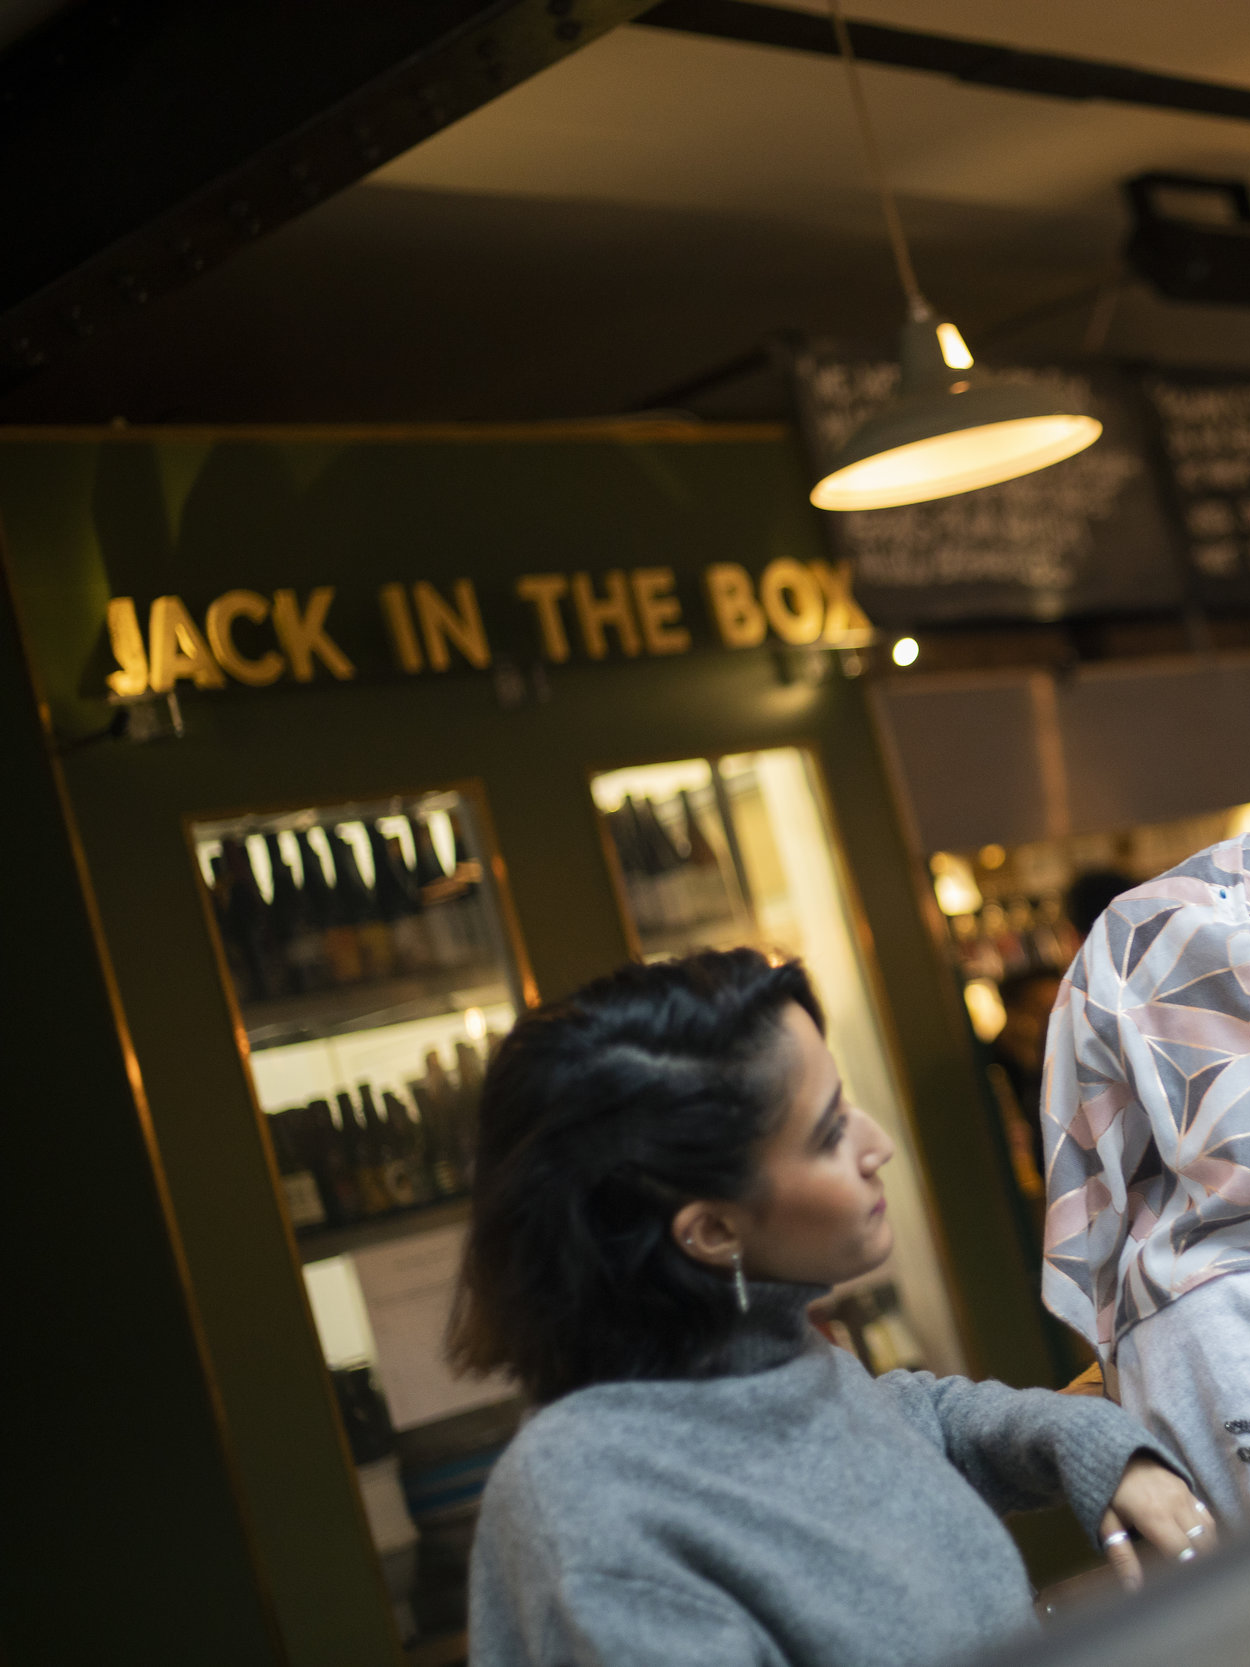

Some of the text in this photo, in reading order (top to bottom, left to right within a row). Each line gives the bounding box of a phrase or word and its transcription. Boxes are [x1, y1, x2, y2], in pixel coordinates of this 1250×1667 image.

[106, 556, 873, 697] JACK IN THE BOX
